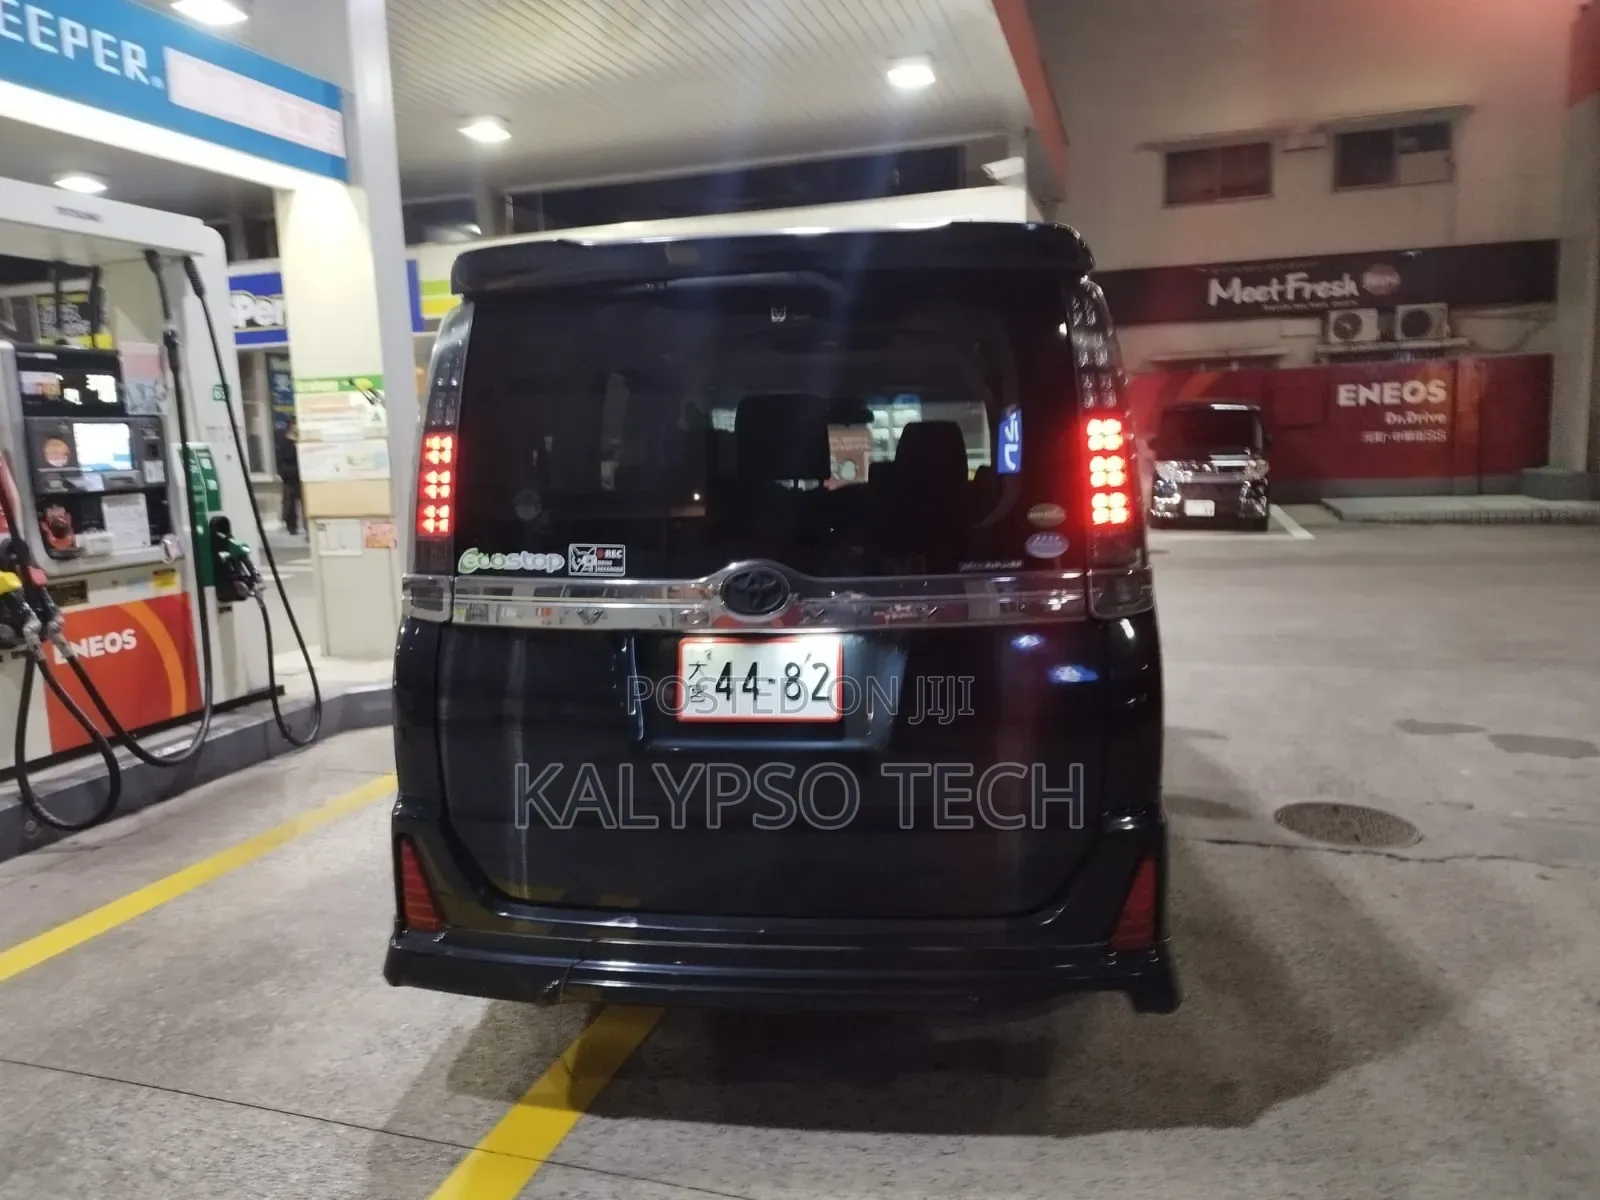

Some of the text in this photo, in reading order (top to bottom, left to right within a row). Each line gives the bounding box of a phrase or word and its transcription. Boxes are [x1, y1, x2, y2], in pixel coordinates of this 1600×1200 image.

[1336, 379, 1447, 407] ENEOS
[604, 549, 623, 559] REC
[715, 661, 831, 702] 44-82
